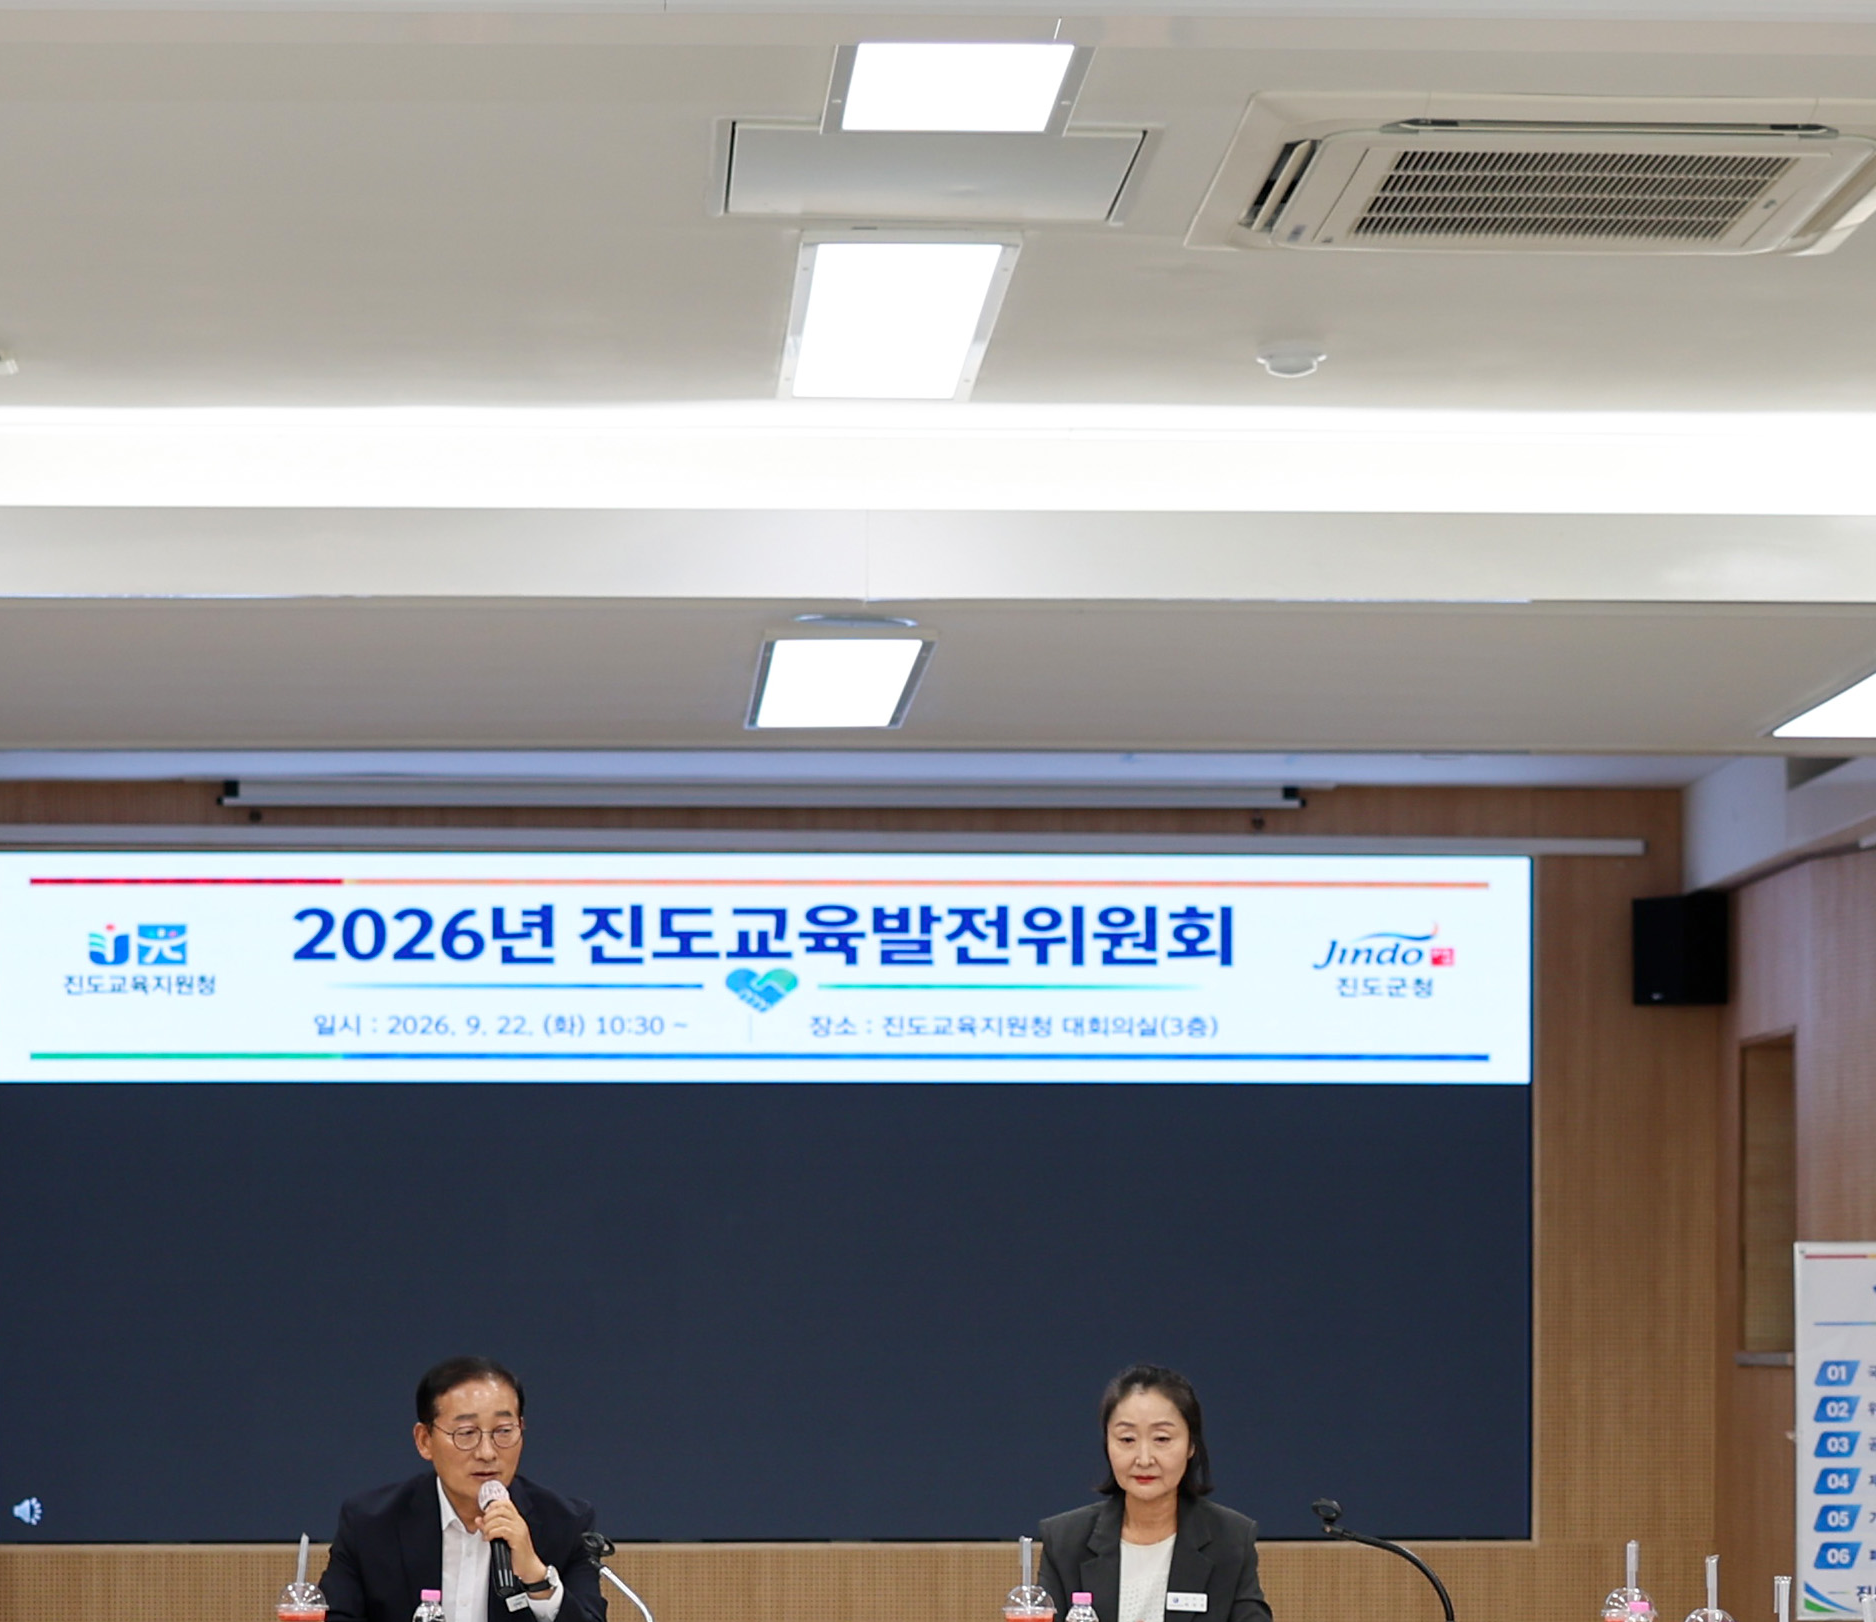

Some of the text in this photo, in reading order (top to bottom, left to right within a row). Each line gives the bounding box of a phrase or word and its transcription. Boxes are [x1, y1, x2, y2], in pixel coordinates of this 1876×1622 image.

[293, 904, 1232, 966] 2026년 진도교육발전위원회
[1313, 938, 1425, 969] Jindo
[65, 975, 215, 995] 진도교육지원청
[1338, 977, 1433, 998] 진도군청
[314, 1015, 360, 1036] 일시
[388, 1015, 455, 1036] 2026.
[466, 1016, 486, 1035] 9.
[497, 1015, 533, 1036] 22.
[543, 1014, 585, 1037] (화)
[597, 1016, 665, 1035] 10:30
[810, 1016, 857, 1037] 장소
[883, 1016, 1052, 1038] 진도교육지원청
[1062, 1016, 1218, 1038] 대회의실(3층)
[1825, 1363, 1848, 1382] 01
[1825, 1400, 1850, 1418] 02
[1825, 1436, 1850, 1454] 03
[1826, 1472, 1851, 1490] 04
[1826, 1510, 1851, 1528] 05
[1826, 1547, 1851, 1565] 06
